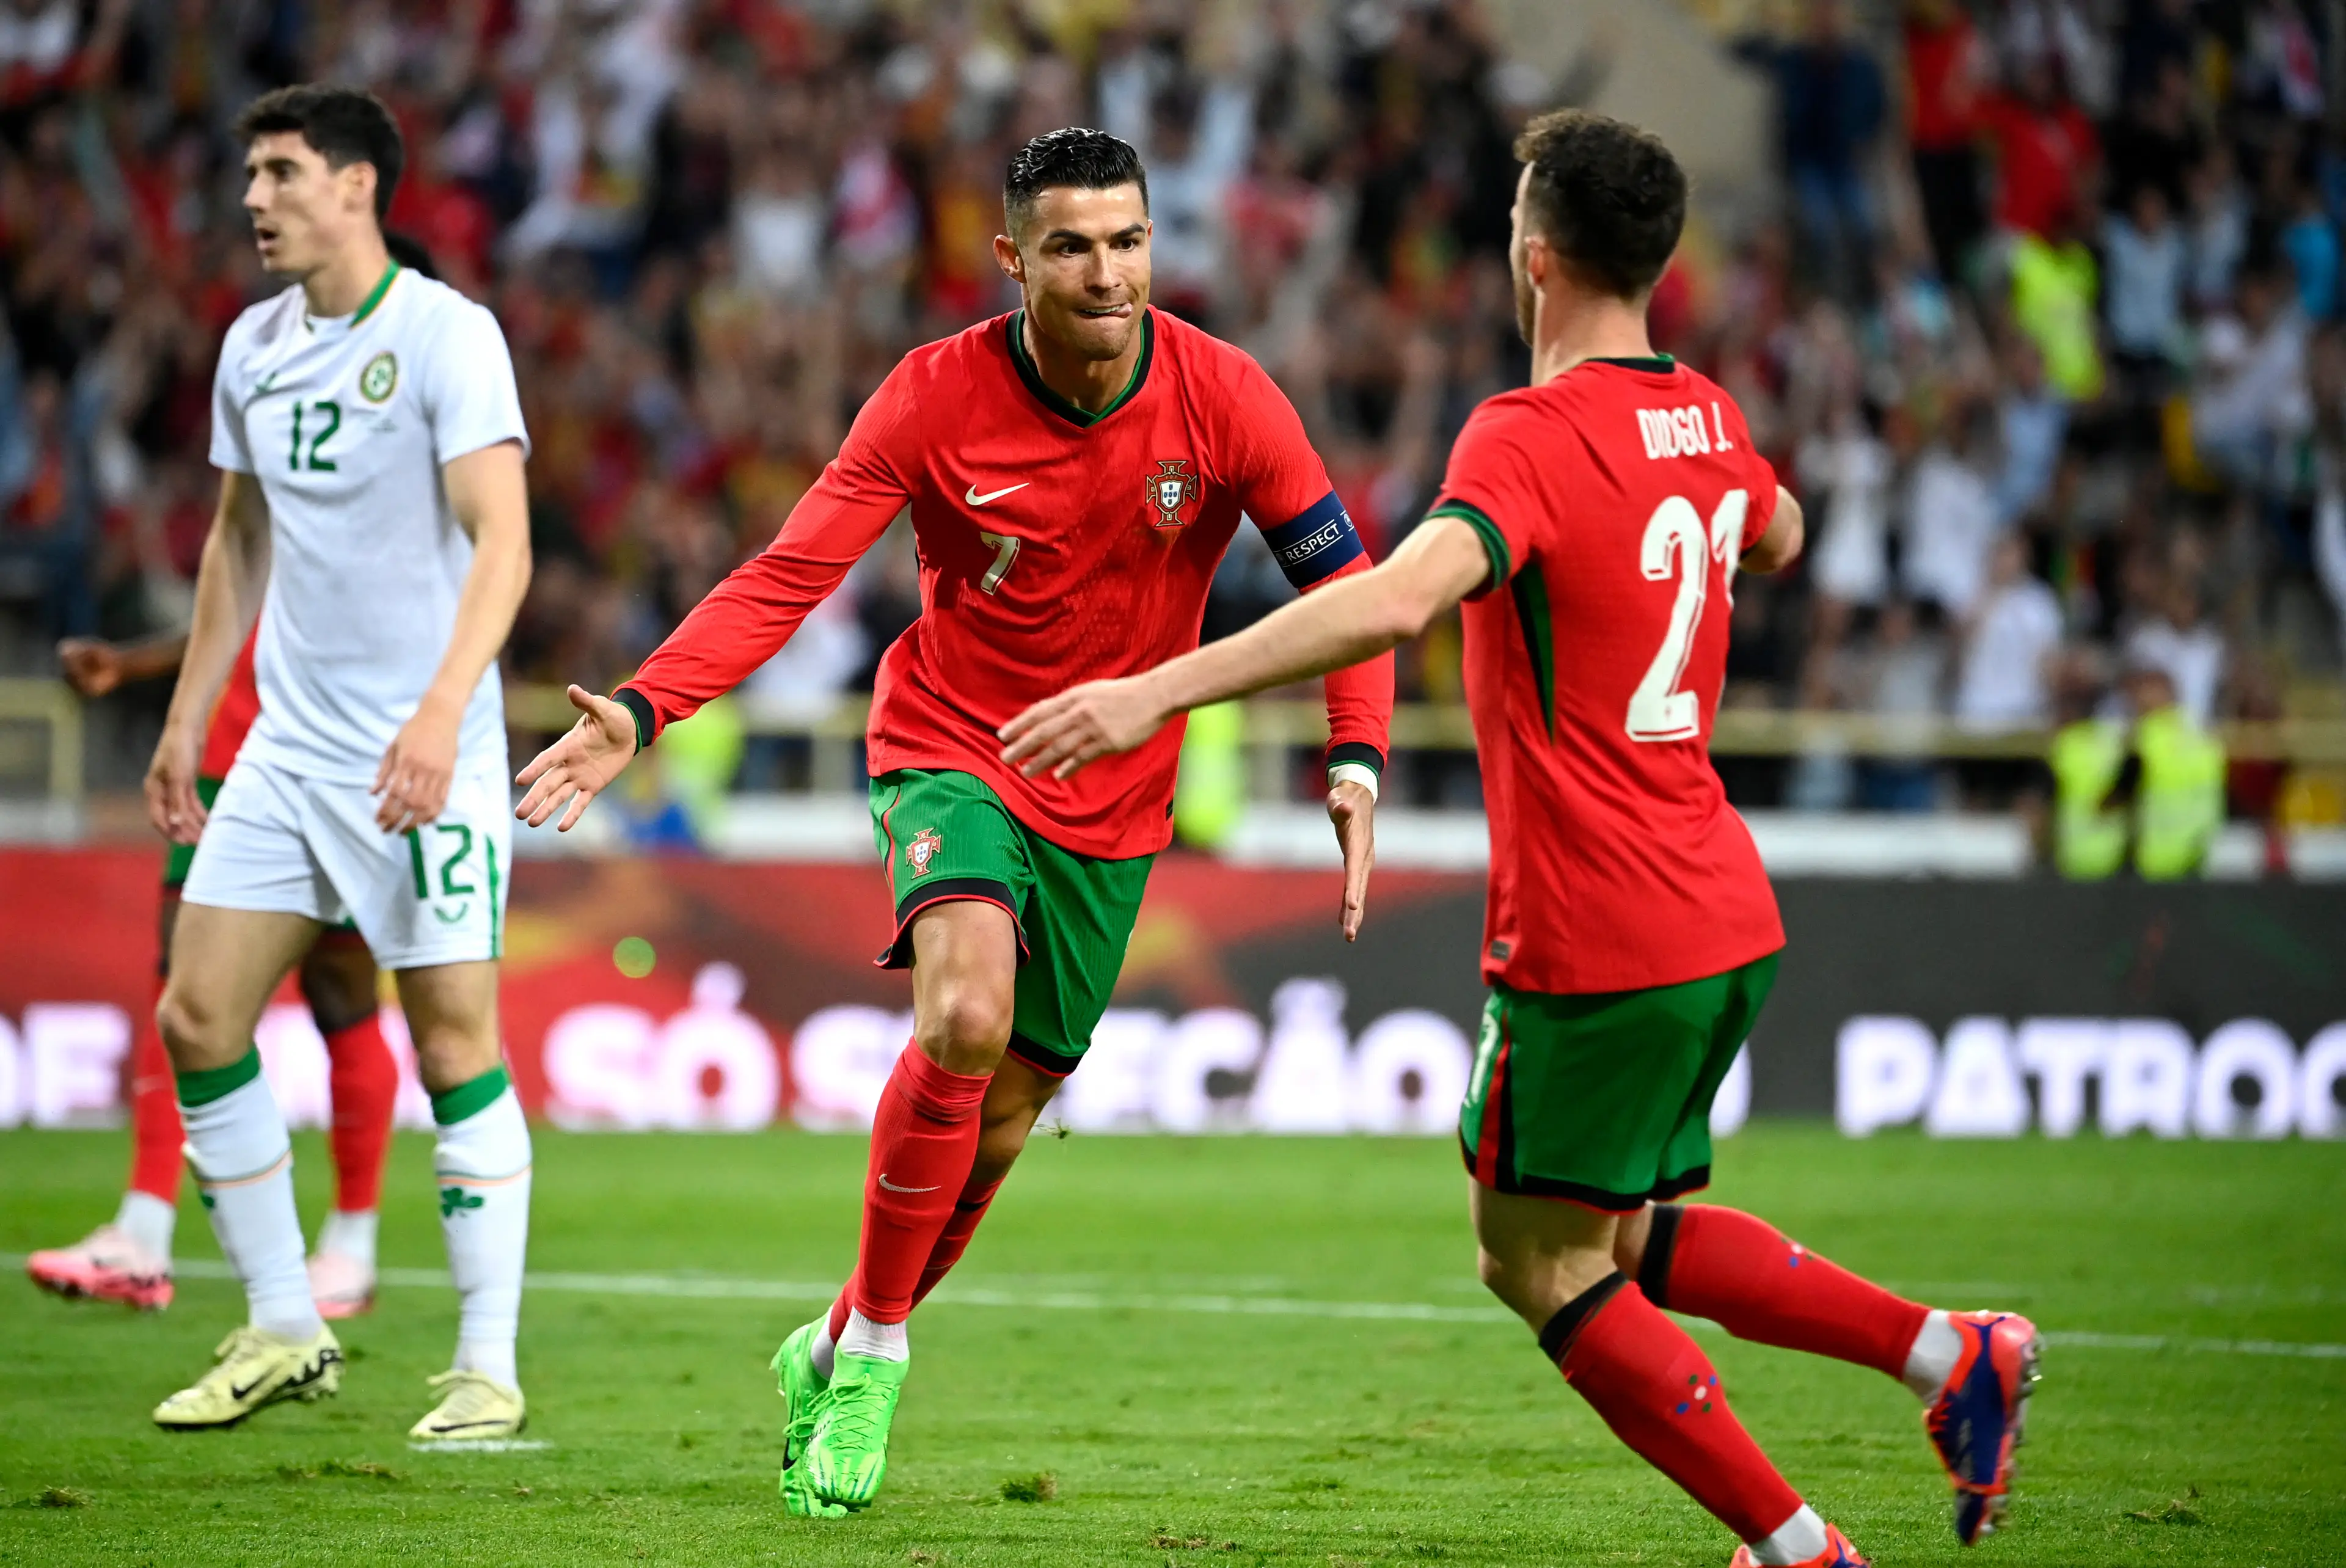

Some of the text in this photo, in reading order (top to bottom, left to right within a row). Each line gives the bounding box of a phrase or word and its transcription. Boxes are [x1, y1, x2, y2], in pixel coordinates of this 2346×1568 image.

[290, 401, 340, 470] 12
[1635, 401, 1733, 459] DIOGO J.
[980, 531, 1020, 596] 7
[1286, 523, 1339, 561] RESPECT
[1625, 489, 1749, 742] 21
[407, 823, 474, 899] 12
[543, 961, 781, 1132] SÓ
